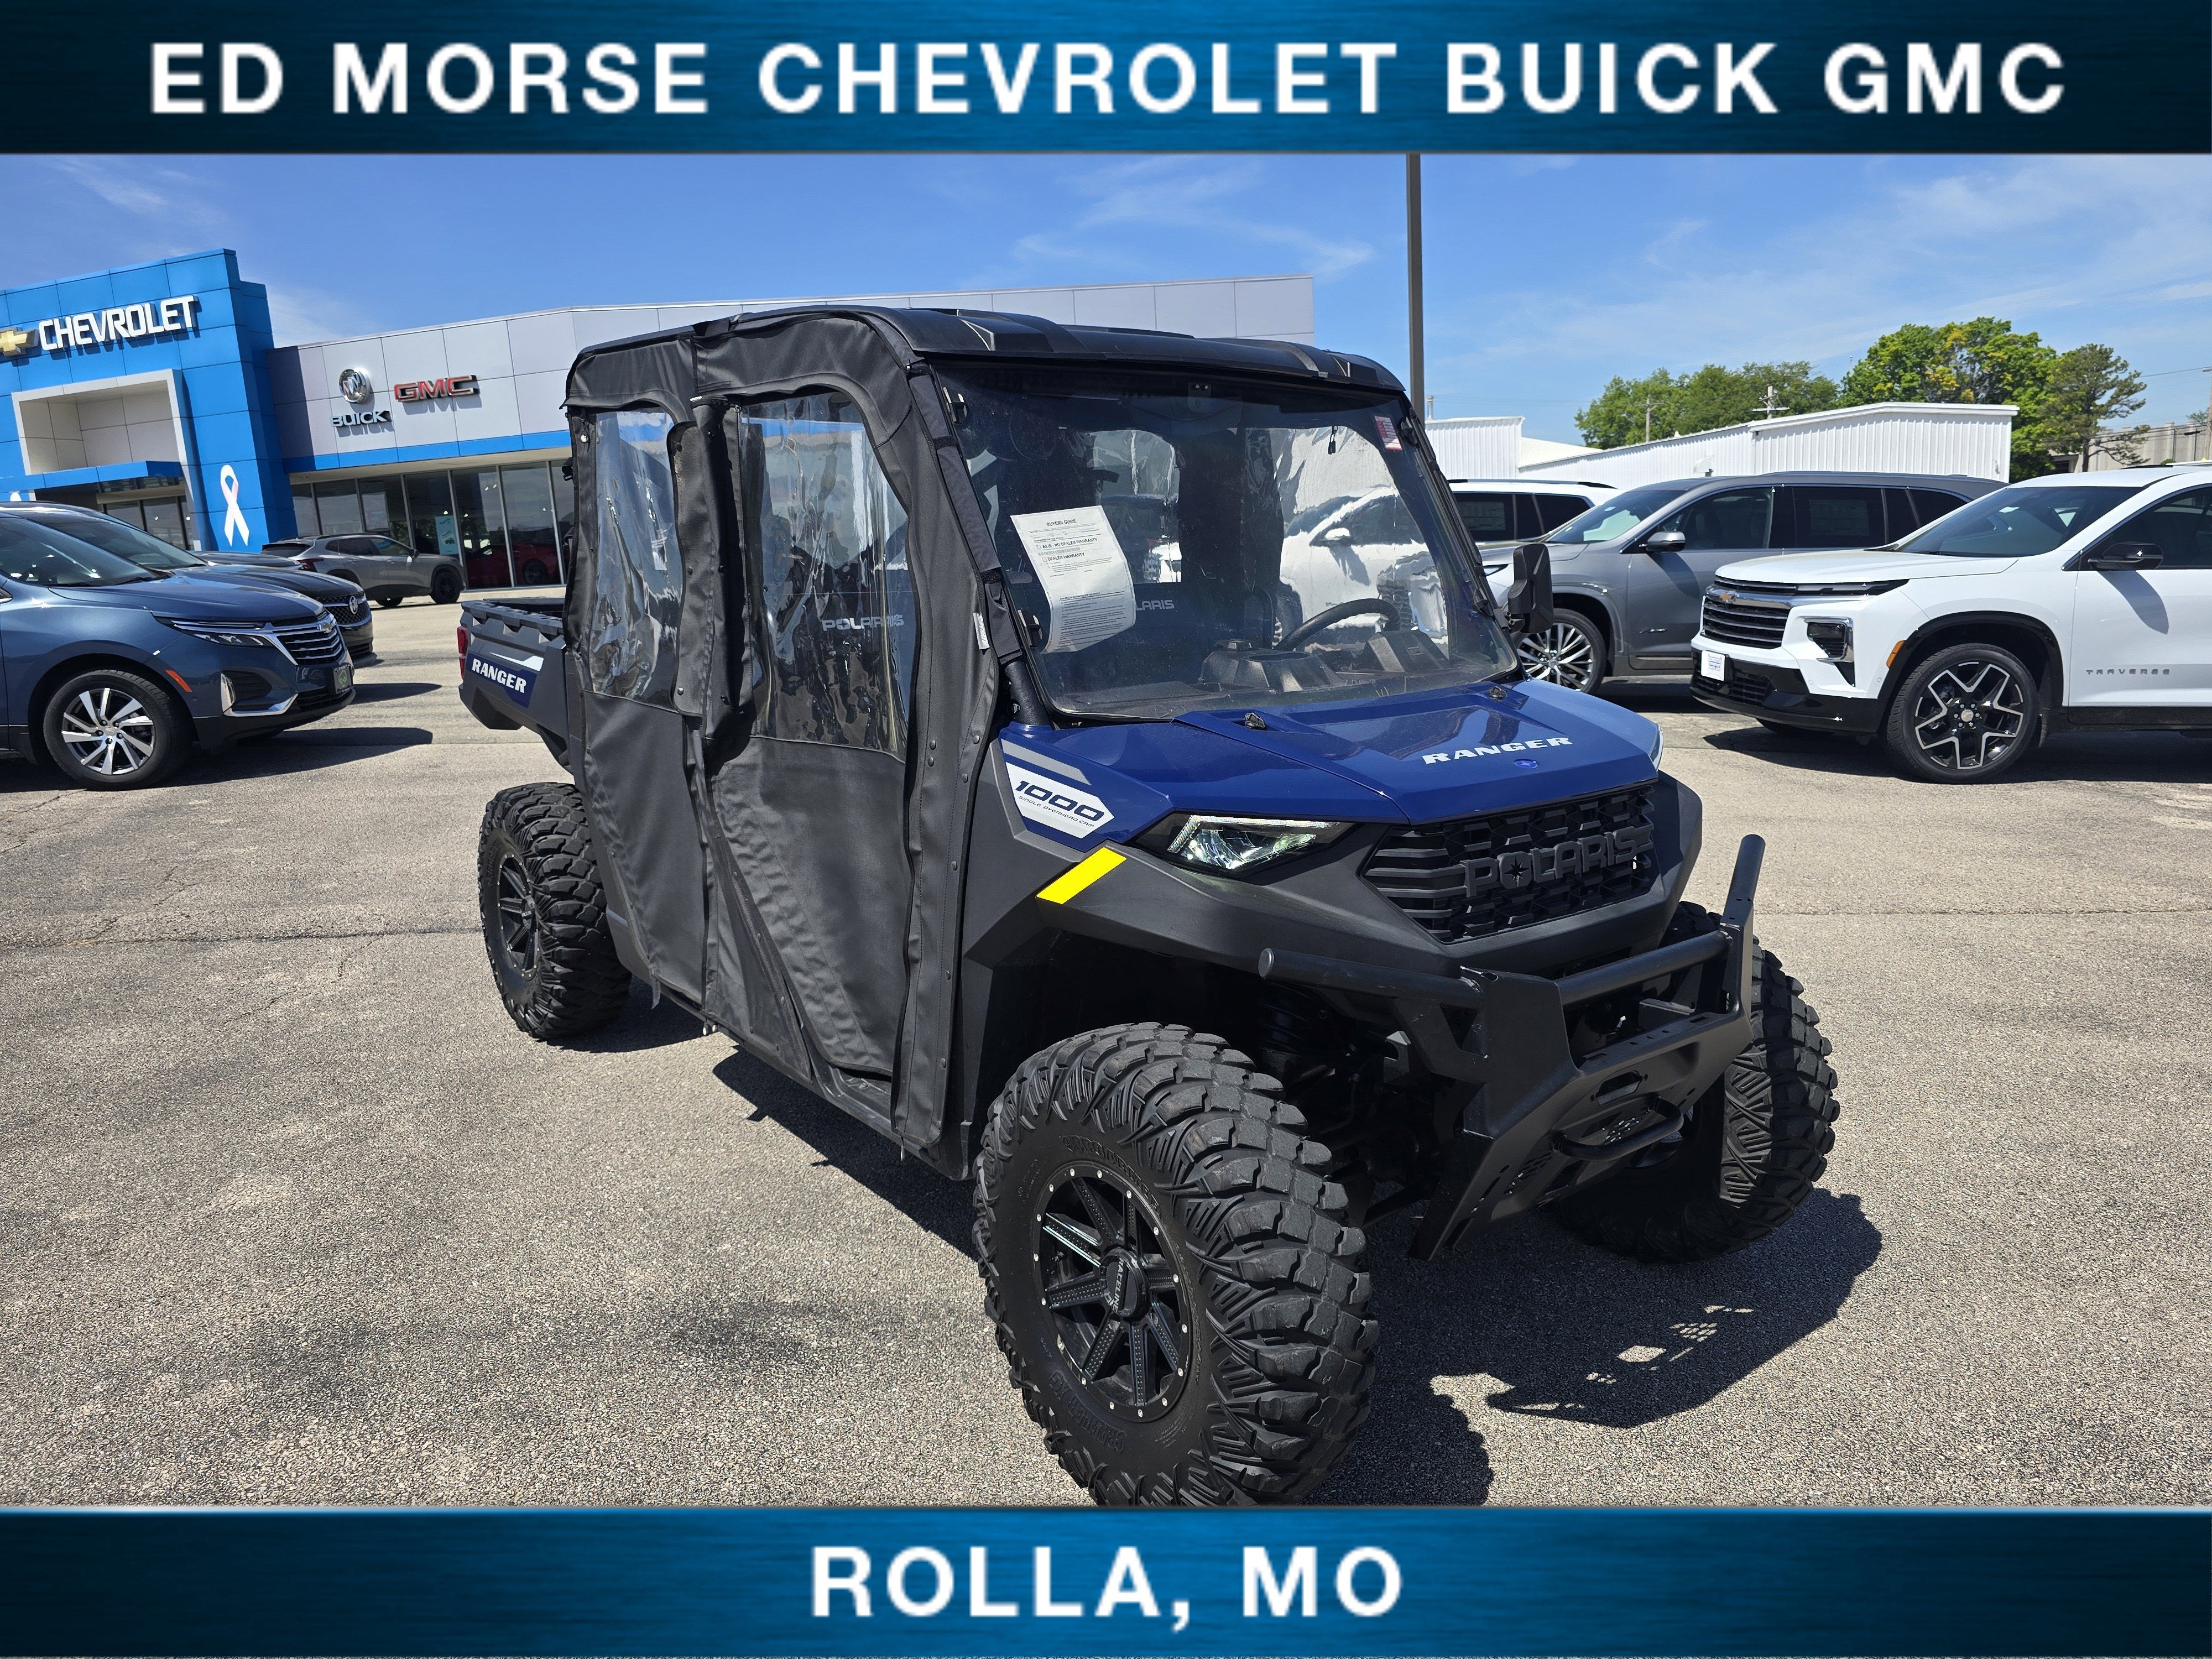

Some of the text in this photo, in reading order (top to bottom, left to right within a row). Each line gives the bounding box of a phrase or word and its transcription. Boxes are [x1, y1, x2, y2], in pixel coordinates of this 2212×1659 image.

[39, 295, 195, 351] CHEVROLET
[394, 374, 476, 402] GMC
[331, 411, 389, 427] BUICK
[1136, 599, 1175, 611] LARIS
[821, 614, 905, 632] POLARIS
[472, 658, 527, 693] RANGER
[1422, 737, 1573, 764] RANGER
[1015, 780, 1105, 822] 1000
[1018, 796, 1095, 828] SINGLE OVERHEAD CAM
[1460, 826, 1637, 898] POLARIS
[1113, 1257, 1124, 1313] RACELINE
